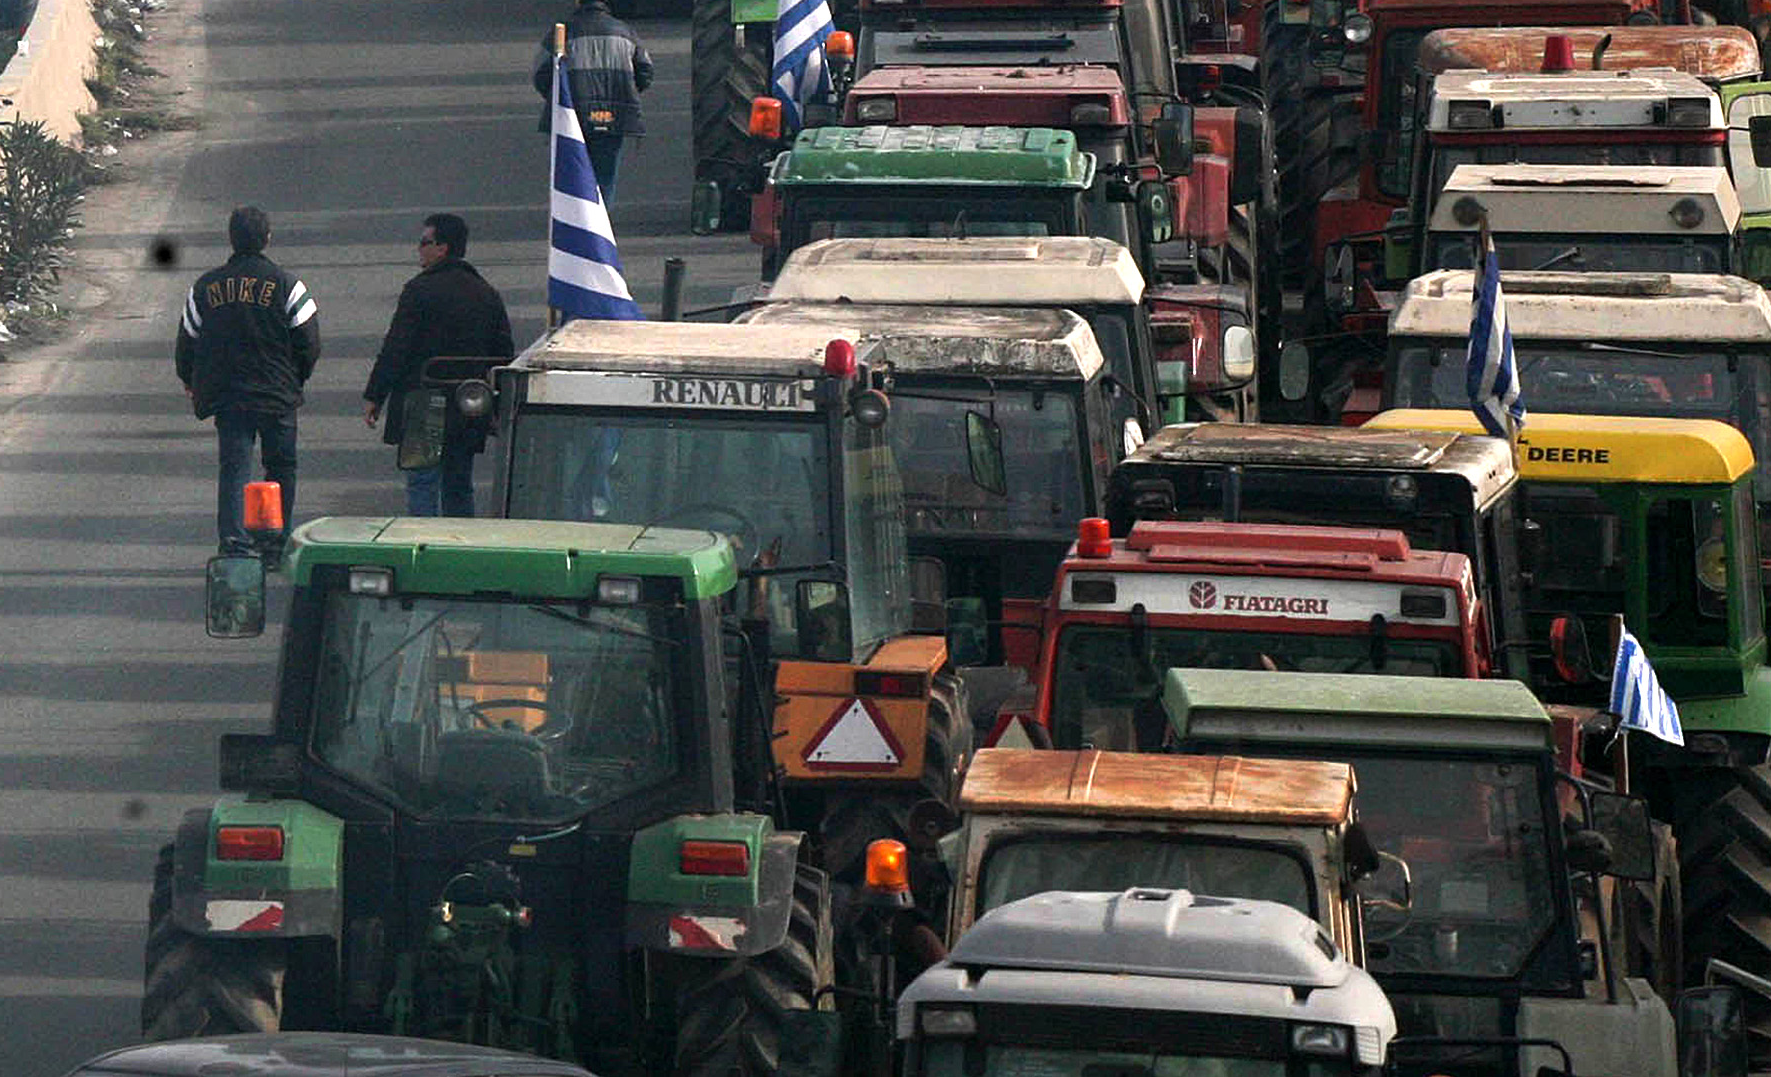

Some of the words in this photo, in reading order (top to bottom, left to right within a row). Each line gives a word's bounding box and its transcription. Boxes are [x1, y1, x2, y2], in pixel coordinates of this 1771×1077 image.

[206, 277, 276, 308] NIKE
[652, 379, 801, 408] RENAULT
[1528, 447, 1610, 463] DEERE
[1223, 594, 1329, 615] FIATAGRI
